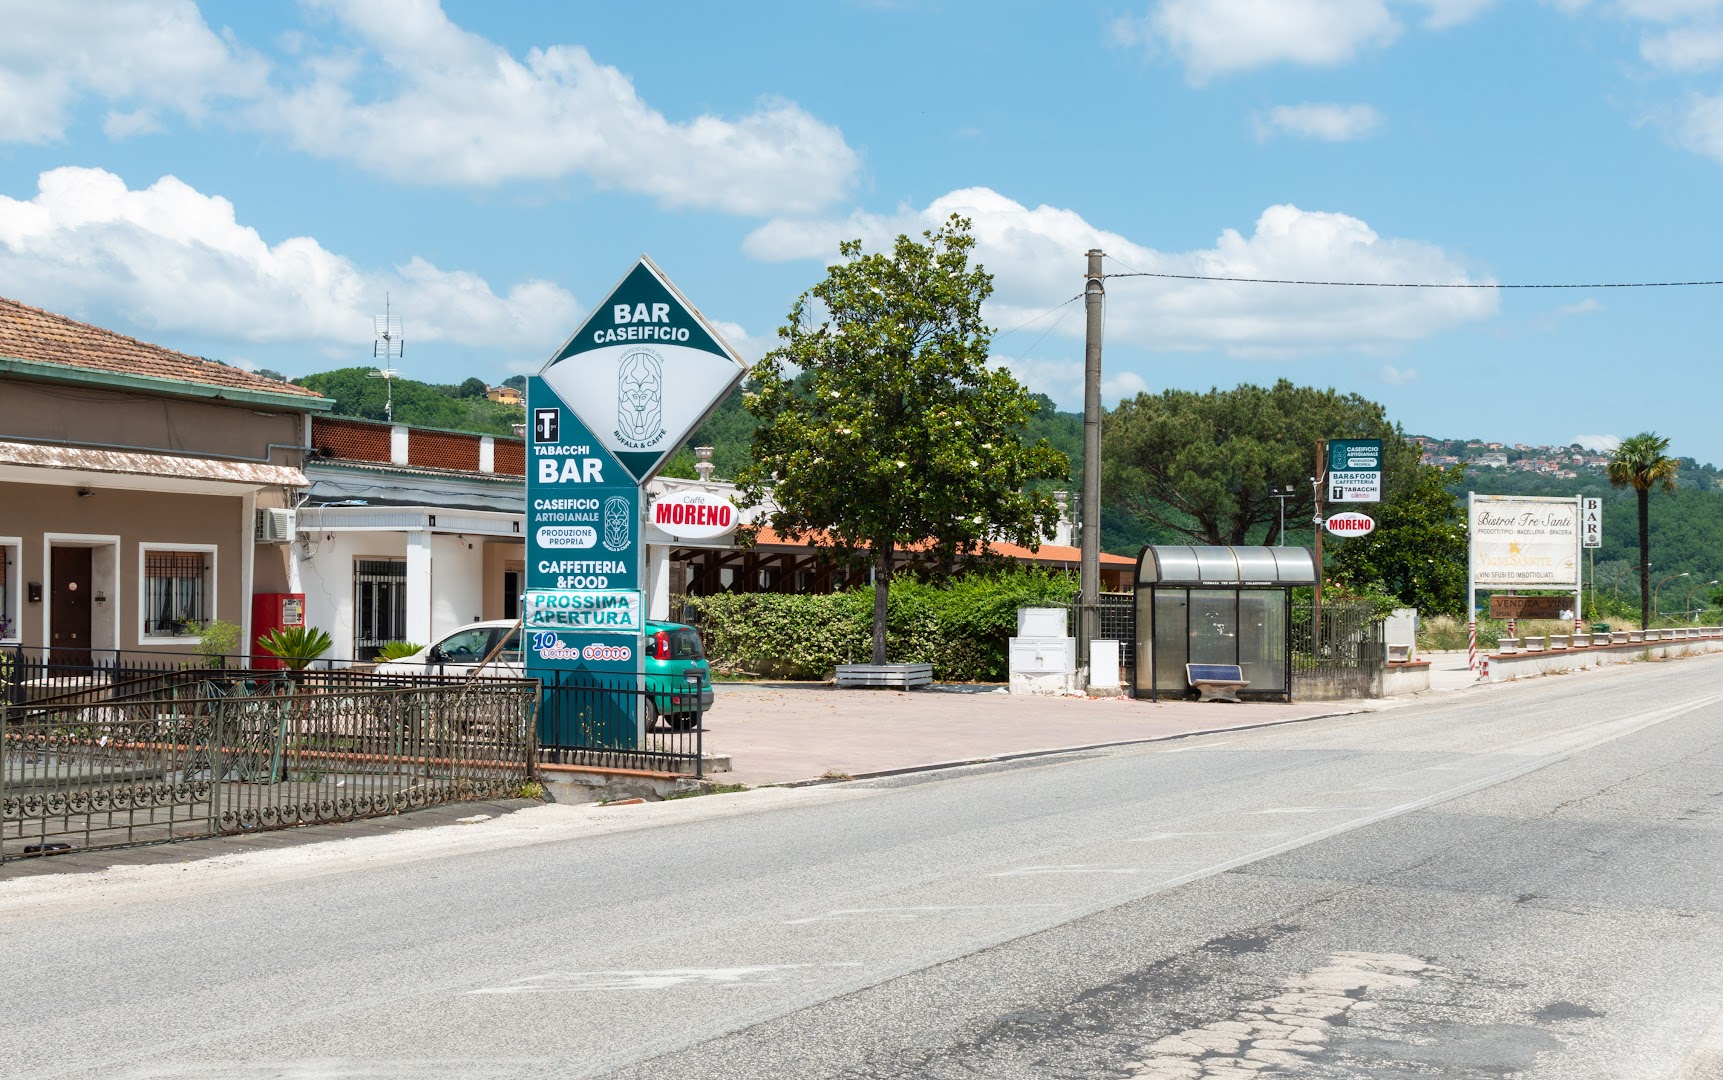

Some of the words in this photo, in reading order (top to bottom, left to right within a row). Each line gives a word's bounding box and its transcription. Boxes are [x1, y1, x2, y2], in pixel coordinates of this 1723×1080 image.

[613, 302, 670, 325] BAR
[593, 326, 690, 343] CASEIFICIO
[613, 430, 639, 449] BUFALA
[646, 428, 667, 447] CAFFÈ
[533, 445, 590, 456] TABACCHI
[538, 457, 604, 484] BAR
[534, 498, 600, 510] CASEIFICIO
[534, 512, 599, 522] ARTIGIANALE
[656, 503, 731, 528] MORENO
[1477, 511, 1516, 526] Bistrot
[1517, 512, 1540, 527] Tre
[1541, 512, 1572, 527] Santi
[1587, 499, 1598, 534] BAR
[1329, 519, 1371, 531] MORENO
[541, 529, 592, 537] PRODUZIONE
[549, 537, 584, 546] PROPRIA
[538, 560, 627, 574] CAFFETTERIA
[556, 575, 608, 589] &FOOD
[1480, 571, 1490, 579] VINI
[1491, 571, 1506, 579] SFUSI
[1507, 571, 1515, 579] ED
[1515, 571, 1554, 579] IMBOTTIGLIATI
[534, 594, 630, 609] PROSSIMA
[1496, 599, 1540, 608] VENDITA
[532, 611, 632, 625] APERTURA
[534, 632, 557, 650] 10
[541, 648, 580, 660] LOTTO
[584, 646, 631, 660] LOTTO
